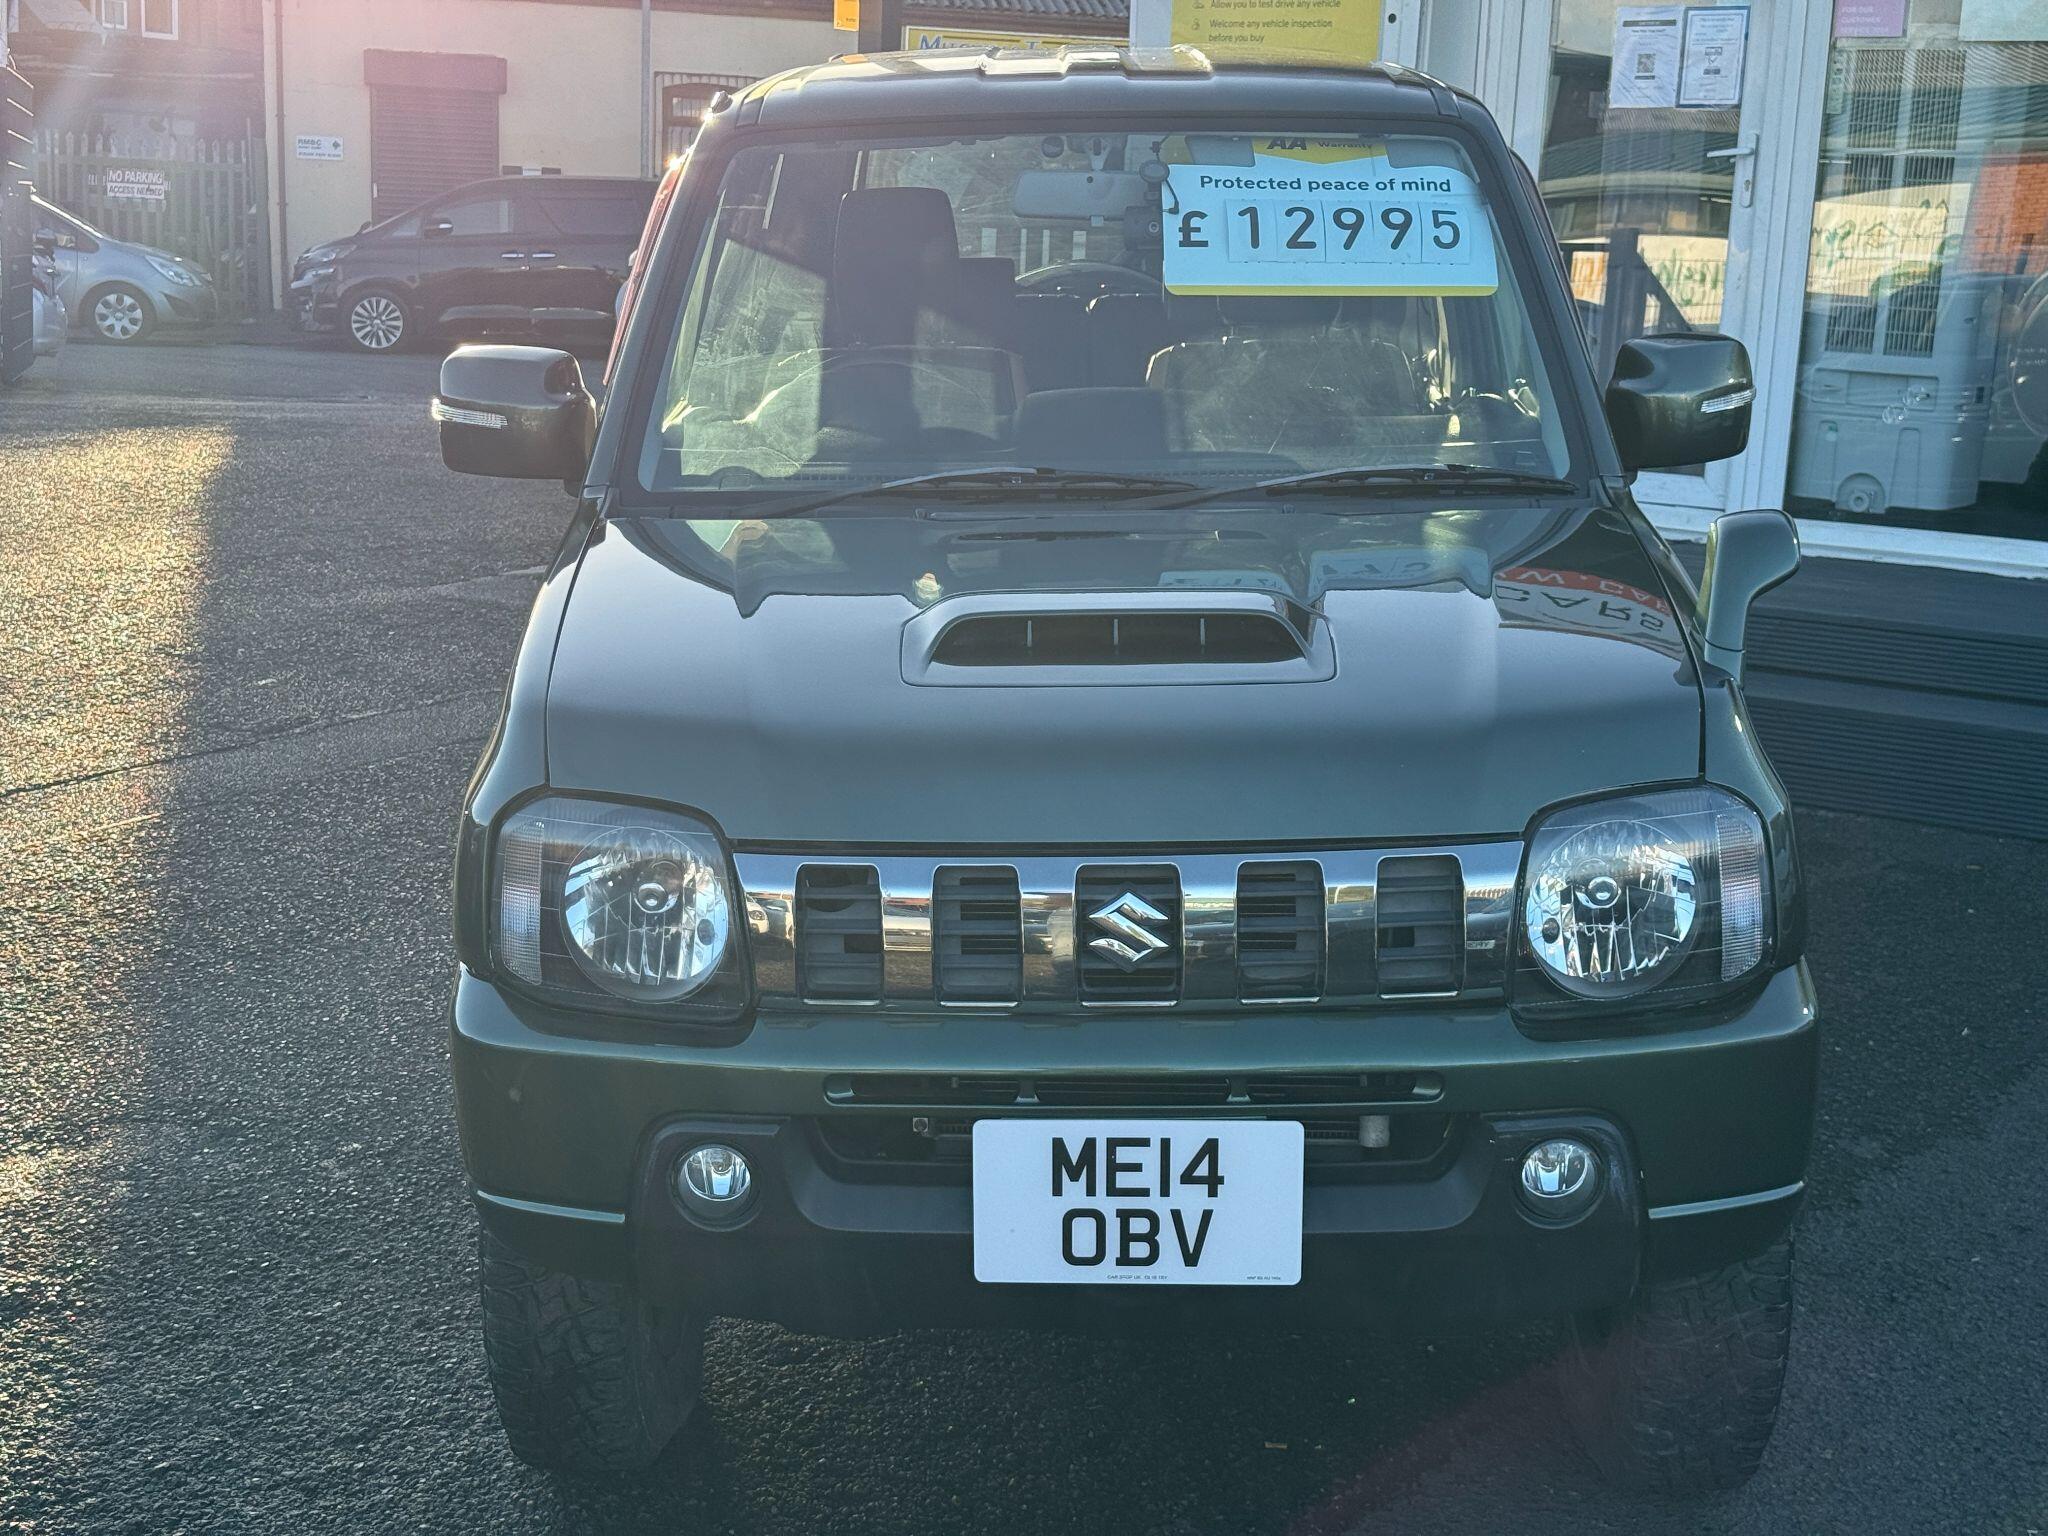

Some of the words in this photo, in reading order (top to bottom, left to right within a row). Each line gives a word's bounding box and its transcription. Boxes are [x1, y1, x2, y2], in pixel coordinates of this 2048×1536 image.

[1210, 0, 1231, 8] Allow
[1233, 1, 1247, 10] you
[1249, 0, 1257, 8] to
[1275, 0, 1294, 8] drive
[1297, 0, 1310, 9] any
[1312, 0, 1341, 8] vehicle
[1209, 19, 1244, 28] Welcome
[1246, 21, 1260, 30] any
[1262, 19, 1289, 28] vehicle
[1291, 19, 1333, 29] inspection
[1208, 34, 1232, 42] before
[1234, 35, 1248, 43] you
[1250, 34, 1264, 43] buy
[1267, 136, 1307, 150] AA
[1318, 141, 1373, 150] Warranty
[109, 169, 122, 182] NO
[124, 170, 163, 184] PARKING
[1199, 174, 1301, 191] Protected
[1308, 177, 1370, 193] peace
[1376, 175, 1396, 193] of
[1401, 175, 1451, 193] mind
[1051, 1136, 1225, 1199] ME14
[1061, 1207, 1215, 1268] OBV
